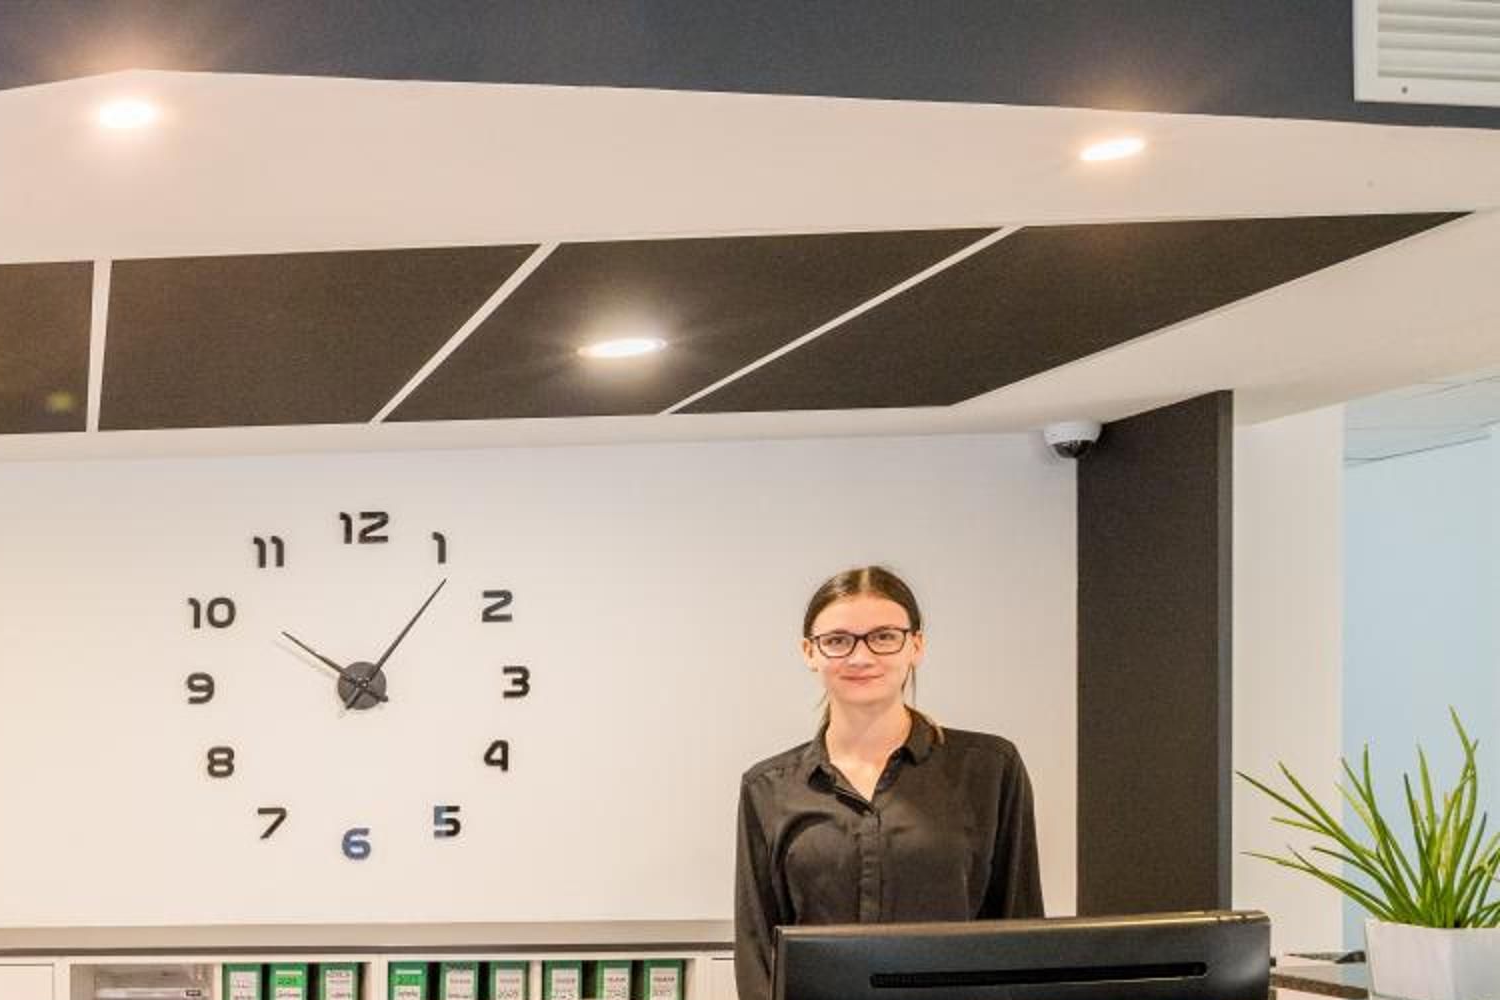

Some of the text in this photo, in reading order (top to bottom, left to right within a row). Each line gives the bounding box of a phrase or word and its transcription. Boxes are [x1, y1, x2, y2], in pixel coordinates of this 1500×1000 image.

[339, 511, 389, 545] 12
[253, 535, 285, 569] 11
[432, 531, 447, 564] 1
[187, 597, 237, 630] 10
[481, 589, 513, 623] 2
[186, 672, 215, 705] 9
[502, 665, 531, 699] 3
[206, 746, 235, 779] 8
[483, 739, 509, 772] 4
[257, 807, 288, 840] 7
[433, 805, 462, 838] 5
[341, 827, 372, 861] 6
